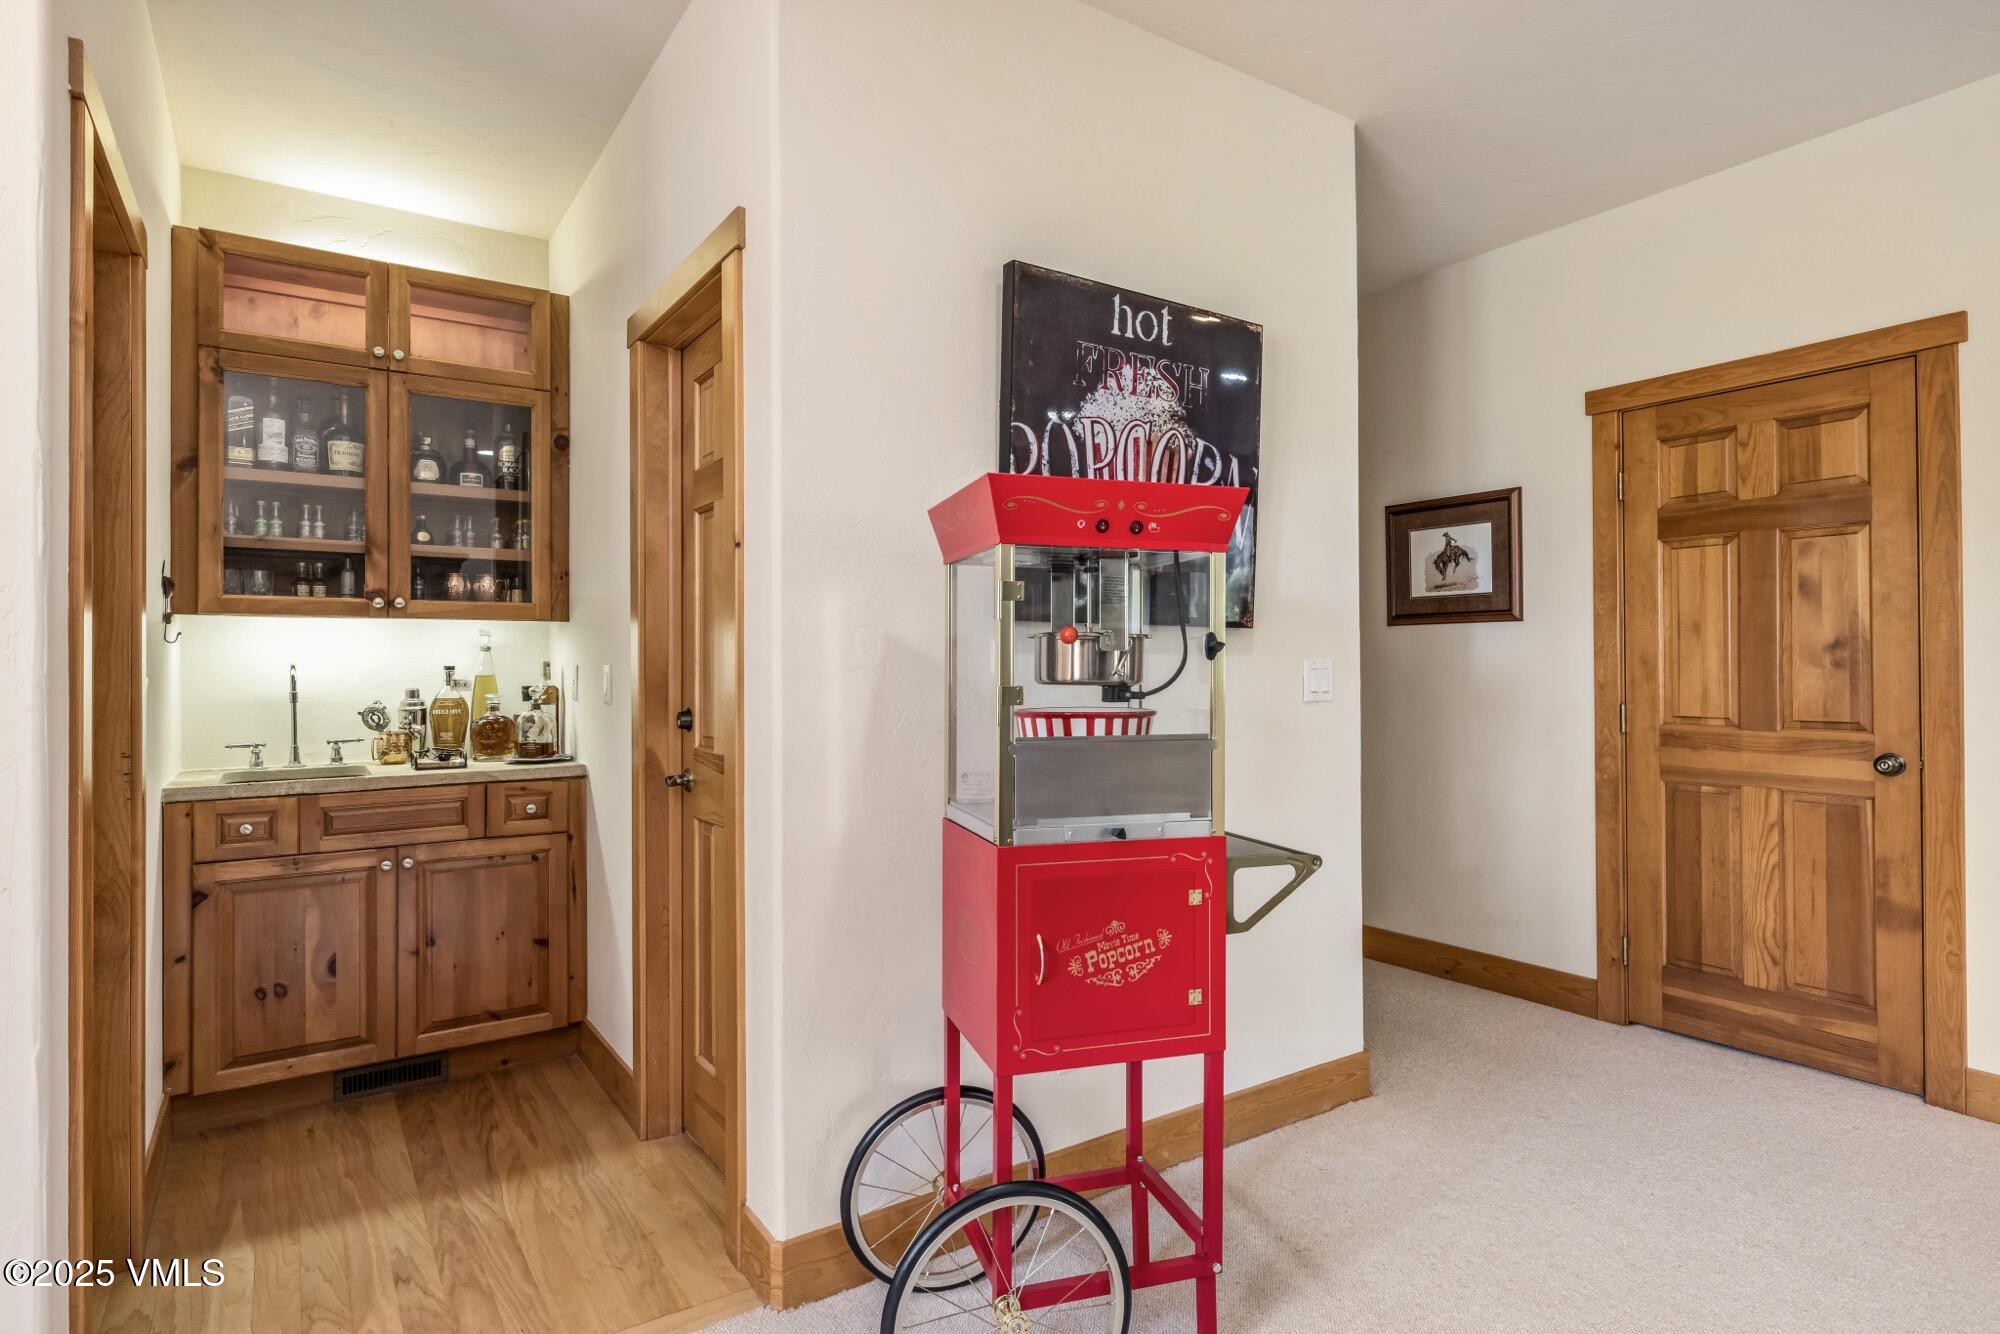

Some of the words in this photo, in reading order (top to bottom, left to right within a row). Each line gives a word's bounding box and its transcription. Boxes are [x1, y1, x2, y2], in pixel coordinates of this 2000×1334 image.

[1111, 292, 1173, 346] hot
[1071, 340, 1210, 408] FRESH
[1084, 938, 1156, 973] Popcorn
[1096, 937, 1120, 952] Movie
[1121, 932, 1140, 944] Time
